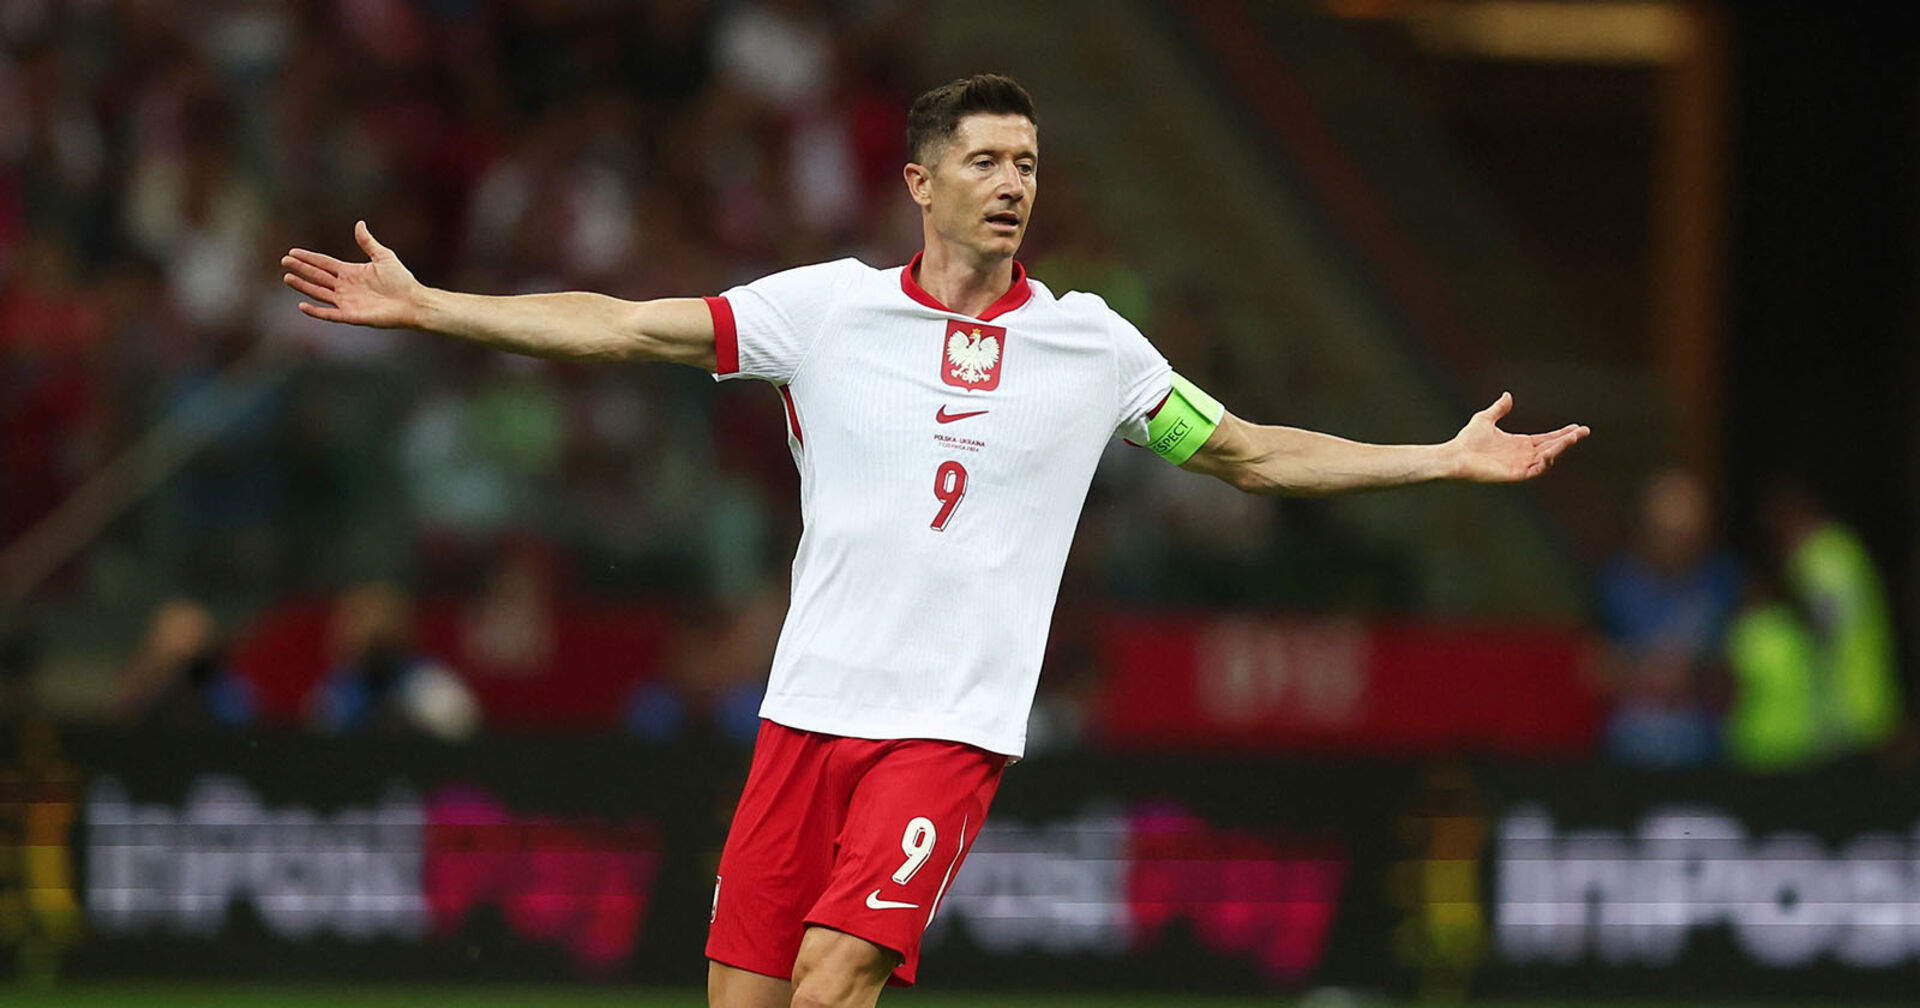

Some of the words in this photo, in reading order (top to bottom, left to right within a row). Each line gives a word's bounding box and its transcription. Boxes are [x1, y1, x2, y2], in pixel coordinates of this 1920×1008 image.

[1152, 419, 1189, 453] ESPECT
[930, 460, 969, 532] 9
[892, 816, 936, 885] 9
[1497, 802, 1920, 967] InPos
